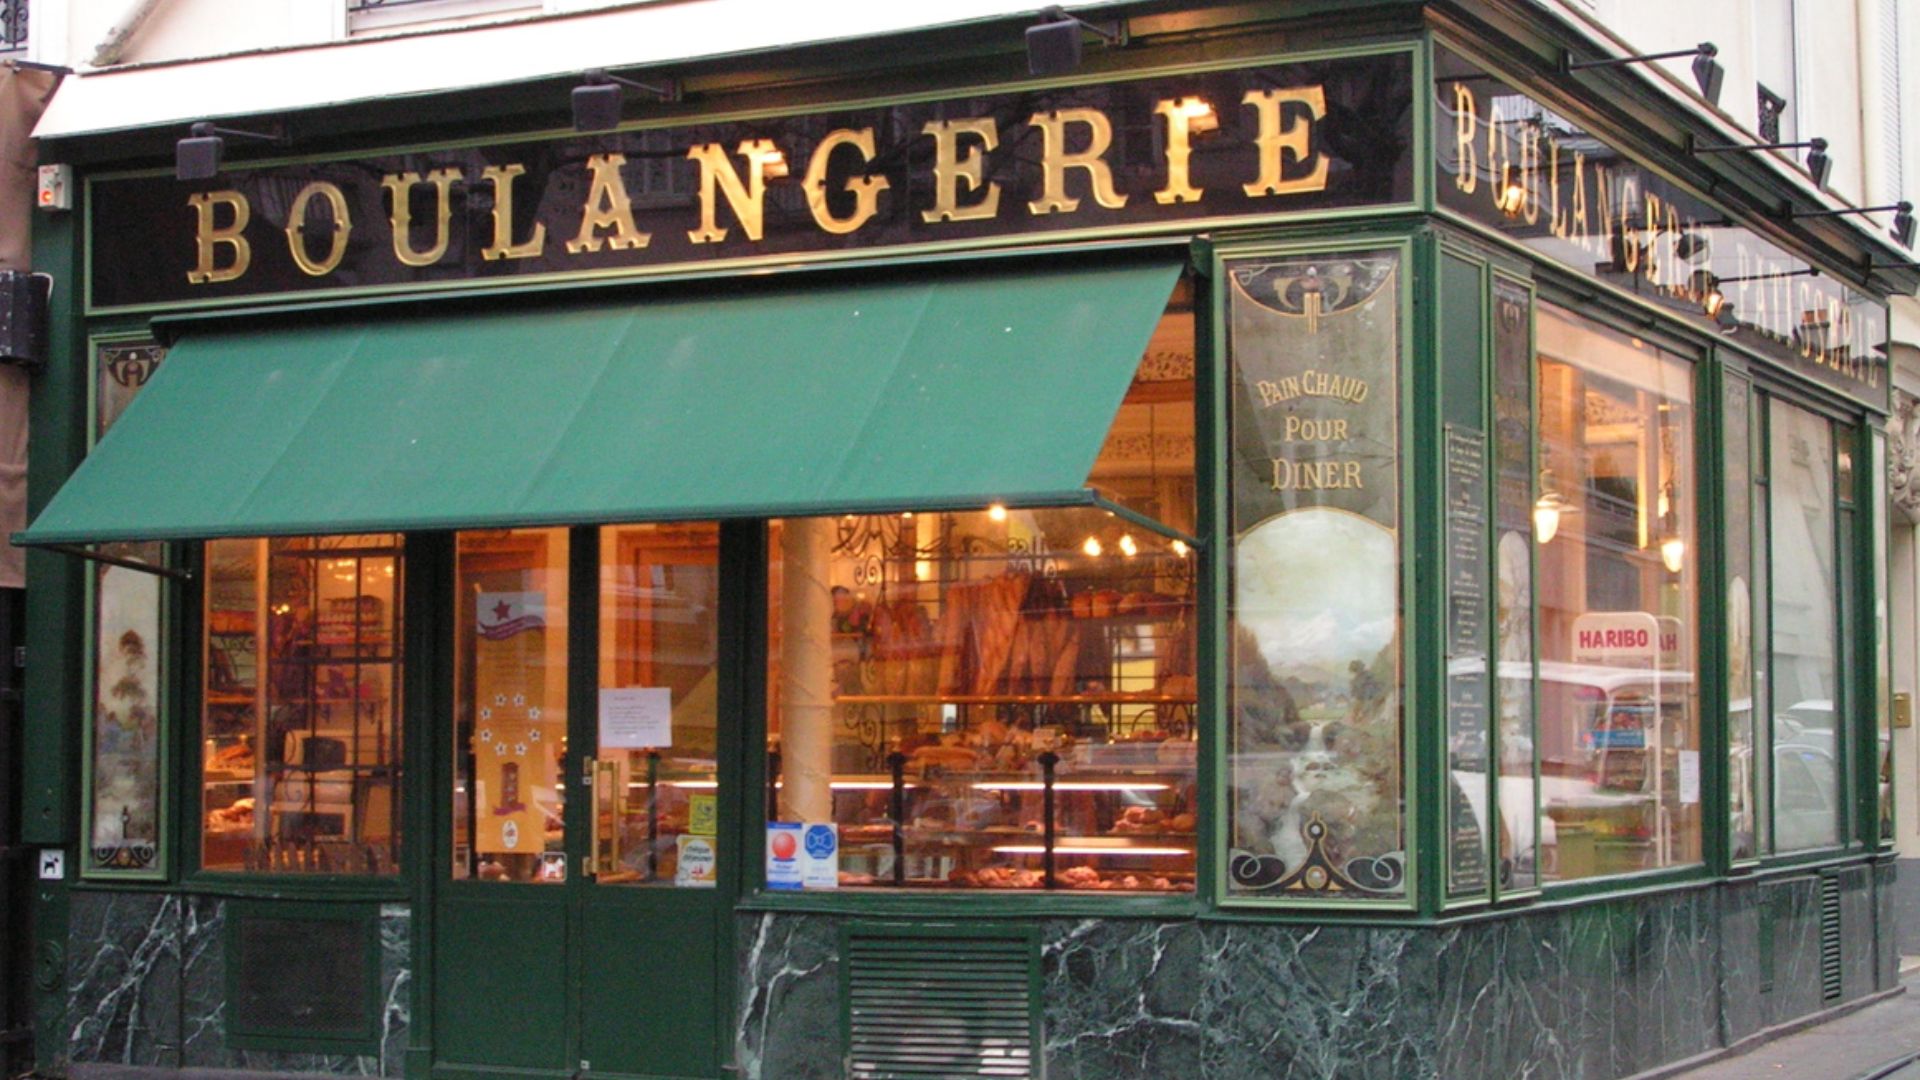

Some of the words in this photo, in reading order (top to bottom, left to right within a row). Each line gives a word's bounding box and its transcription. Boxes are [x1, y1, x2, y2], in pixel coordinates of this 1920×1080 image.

[185, 84, 1330, 285] BOULANGERIE
[1454, 82, 1716, 307] BOULANGERIE
[1258, 376, 1300, 406] PAIN
[1303, 370, 1368, 403] CHAUD
[1284, 415, 1348, 442] POUR
[1271, 458, 1363, 489] DINER
[1579, 629, 1649, 649] HARIBO
